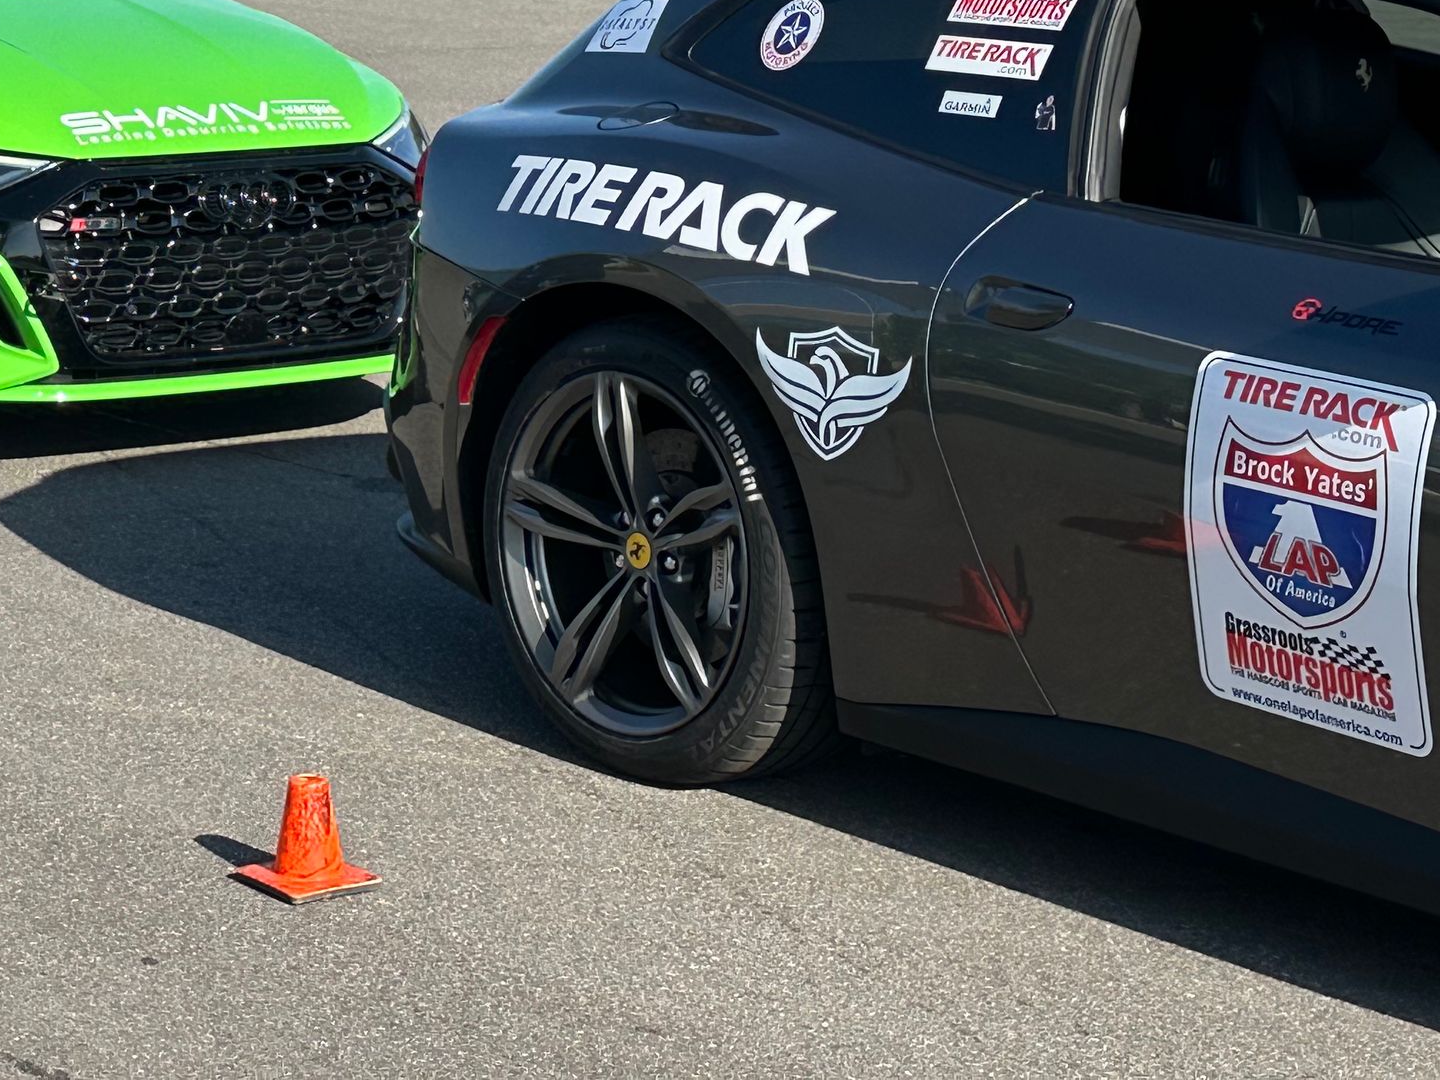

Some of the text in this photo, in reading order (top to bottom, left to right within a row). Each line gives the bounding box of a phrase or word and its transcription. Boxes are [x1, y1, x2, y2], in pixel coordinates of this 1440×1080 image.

[936, 39, 1042, 76] TIRE RACK
[997, 66, 1027, 75] .com
[60, 100, 268, 136] SHAVIV
[945, 100, 991, 115] GARMIN
[74, 119, 352, 146] Leading Deburring Solutions
[496, 154, 837, 276] TIRE RACK
[1224, 370, 1401, 452] TIRE RACK
[1331, 427, 1382, 449] .com
[1233, 450, 1373, 503] Brock Yates'
[1258, 531, 1342, 589] LAP
[1266, 574, 1336, 608] Of America
[1224, 611, 1315, 656] Grassroots
[1226, 631, 1395, 712] Motorsports
